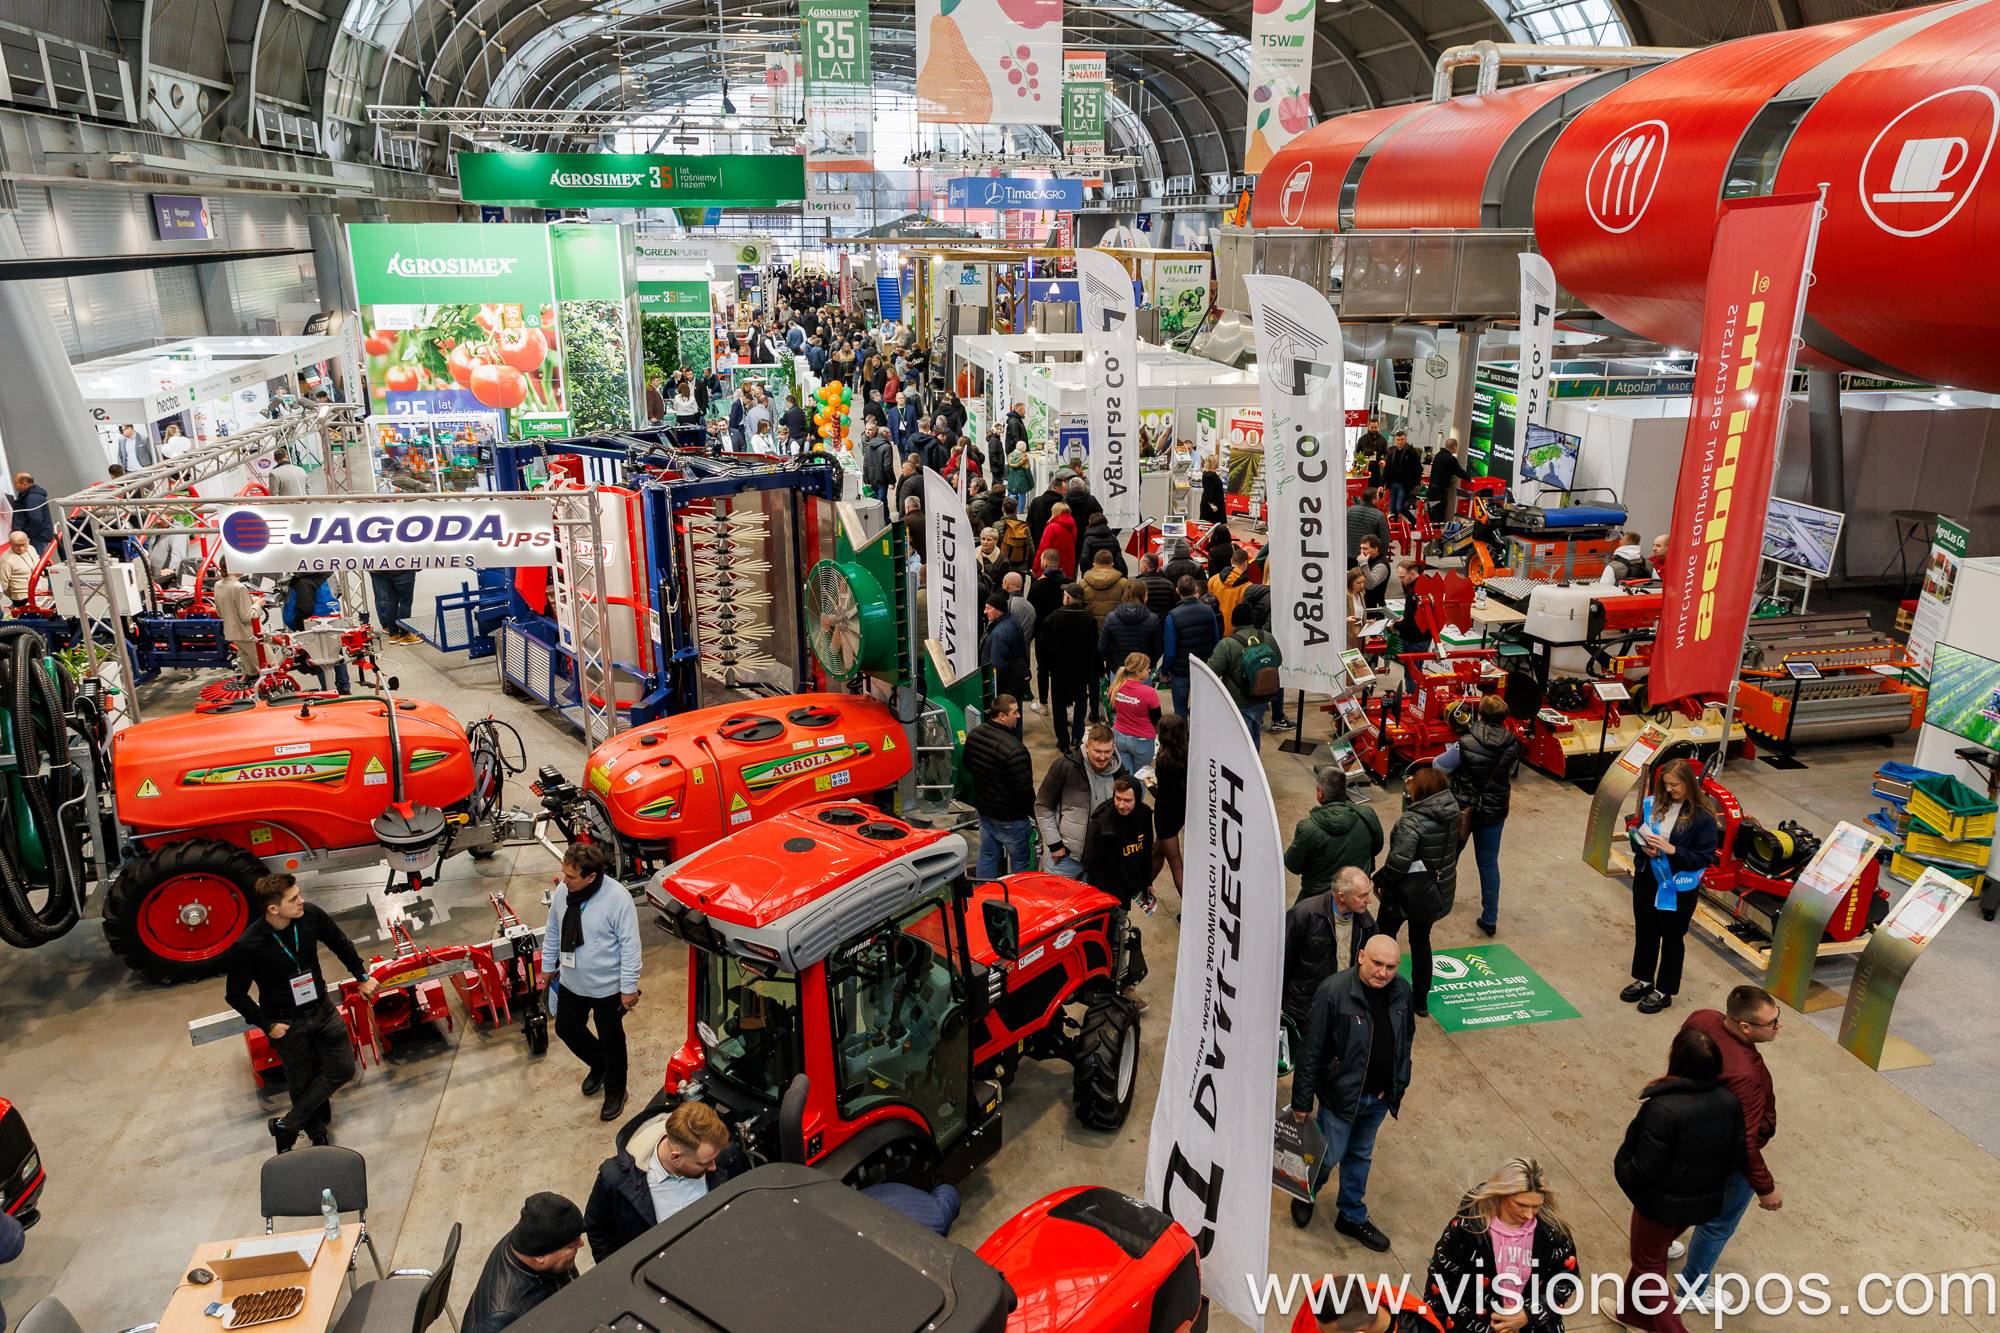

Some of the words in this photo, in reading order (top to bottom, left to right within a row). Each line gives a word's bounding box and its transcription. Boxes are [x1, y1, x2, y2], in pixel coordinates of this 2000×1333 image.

[808, 6, 862, 18] AGROSIMEX
[817, 21, 855, 59] 35
[1260, 34, 1291, 47] TSW
[818, 61, 855, 79] LAT
[1073, 94, 1097, 118] 35
[1073, 119, 1094, 131] LAT
[550, 169, 645, 188] AGROSIMEX
[649, 166, 673, 188] 35
[680, 175, 717, 183] rośniemy
[1005, 187, 1038, 199] Timac
[807, 200, 851, 211] hortico
[1138, 218, 1147, 229] 7
[386, 251, 518, 277] AGROSIMEX
[1162, 265, 1203, 275] VITALFIT
[663, 291, 676, 303] 35
[1666, 382, 1691, 391] MADE
[290, 513, 504, 545] JAGODA
[497, 531, 551, 548] JPS
[1935, 523, 1956, 544] AgroLas
[1956, 535, 1966, 549] Co.
[297, 554, 476, 571] AGROMACHINES
[236, 763, 316, 781] AGROLA
[771, 752, 833, 777] AGROLA
